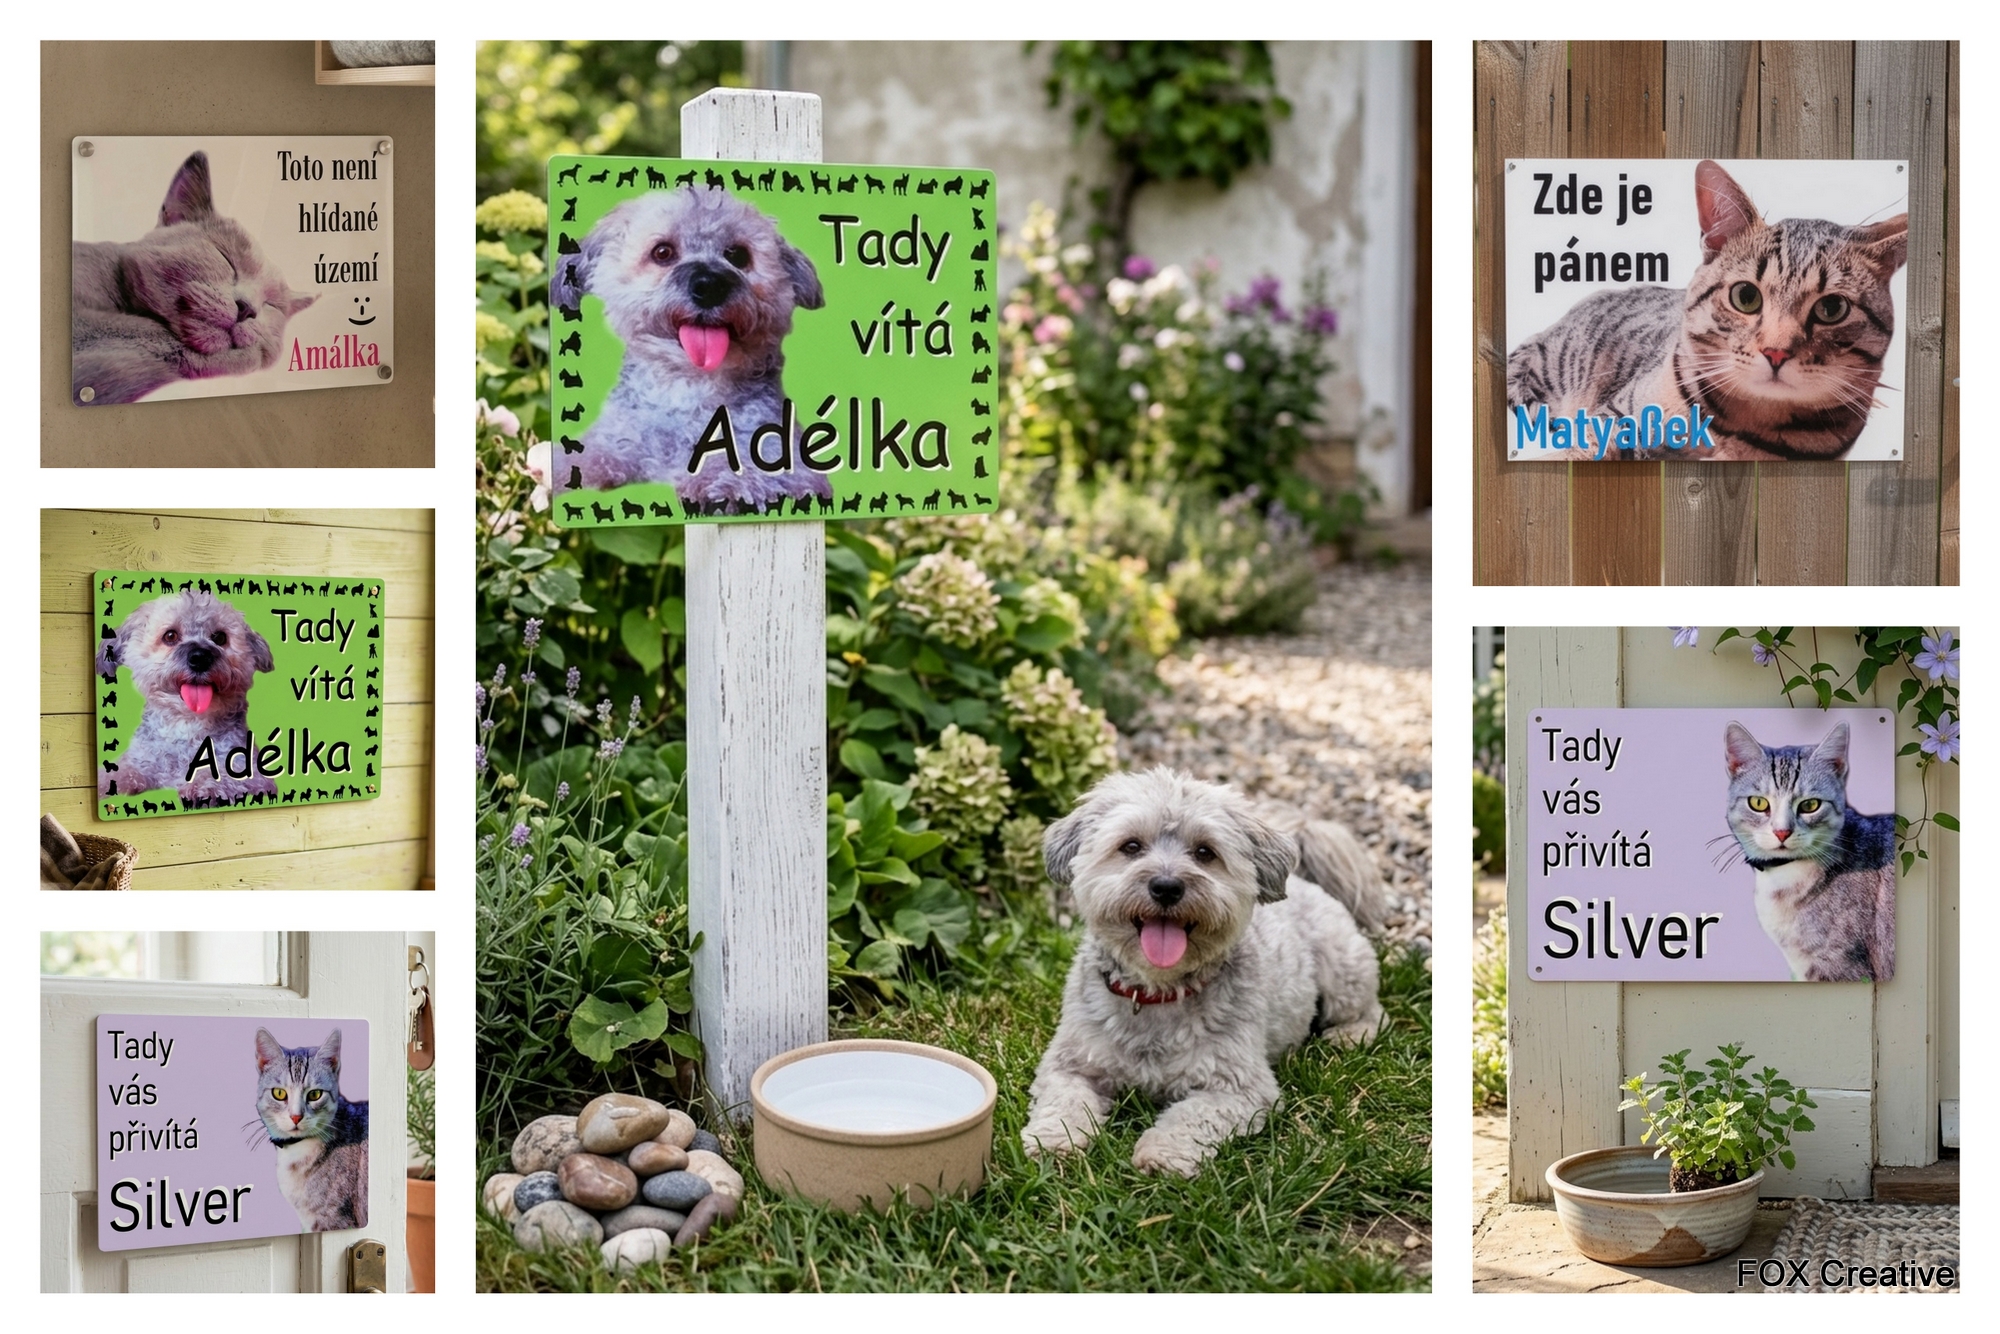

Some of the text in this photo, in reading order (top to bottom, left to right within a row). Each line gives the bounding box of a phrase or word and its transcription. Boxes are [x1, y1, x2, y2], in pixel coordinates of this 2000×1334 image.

[277, 151, 378, 181] Toto není
[298, 202, 378, 233] hlídané
[1533, 173, 1653, 226] Zde je
[314, 252, 378, 283] území
[818, 213, 952, 283] Tady
[1534, 236, 1670, 293] pánem
[850, 300, 953, 358] vítá
[288, 334, 381, 372] Amálka
[687, 395, 952, 476] Adélka
[271, 607, 356, 654] Tady
[290, 664, 356, 702] vítá
[185, 727, 352, 782] Adélka
[1541, 728, 1622, 772] Tady
[1542, 777, 1602, 816] vás
[1543, 829, 1653, 877] přivítá
[1543, 897, 1722, 959] Silver
[107, 1030, 174, 1069] Tady
[108, 1072, 158, 1107] vás
[109, 1118, 199, 1161] přivítá
[110, 1177, 253, 1232] Silver
